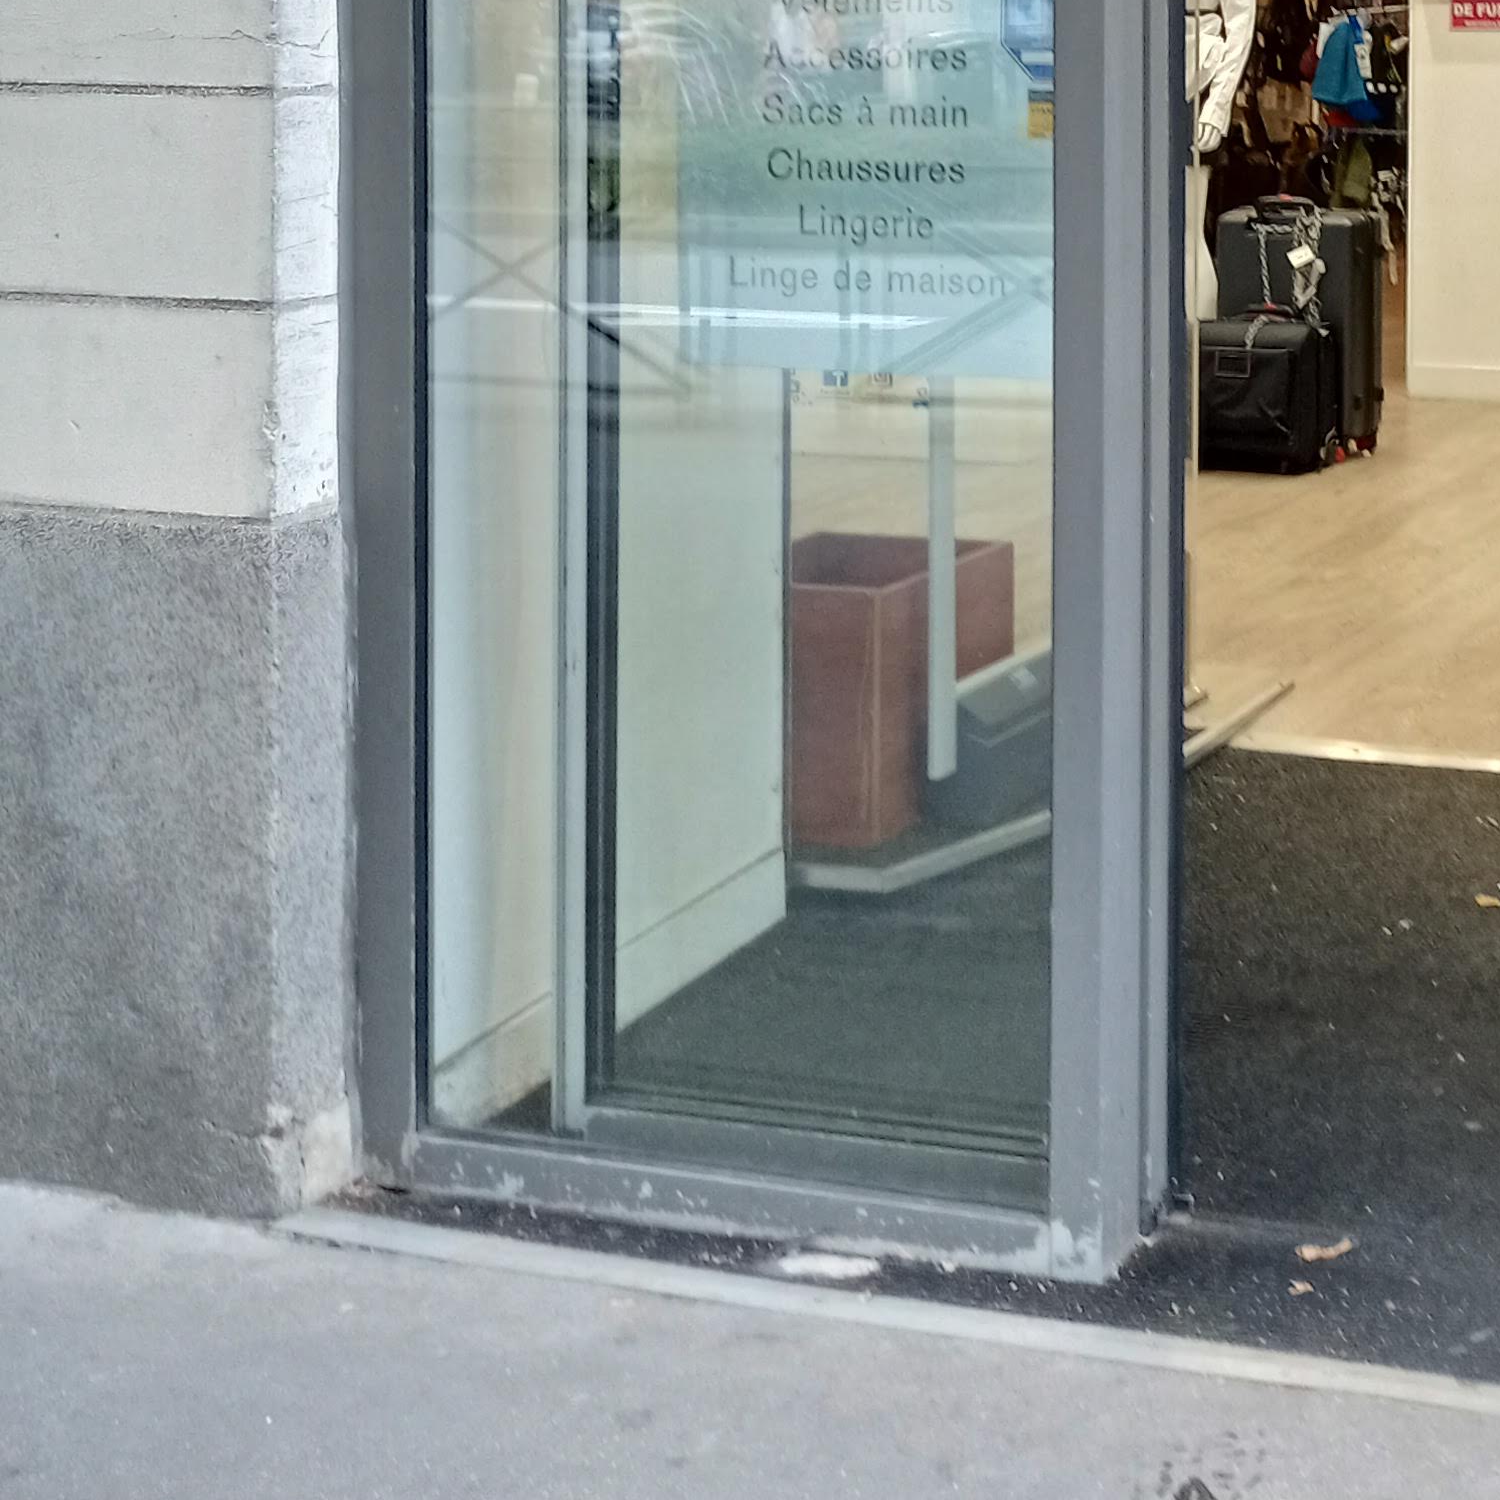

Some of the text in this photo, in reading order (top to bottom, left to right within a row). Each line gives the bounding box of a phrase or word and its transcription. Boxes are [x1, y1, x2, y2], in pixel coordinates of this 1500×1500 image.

[1453, 2, 1474, 18] DE
[762, 94, 968, 128] Sacs à main
[767, 146, 966, 185] Chaussures
[798, 204, 934, 246] Lingerie
[729, 255, 1006, 298] Linge de maison
